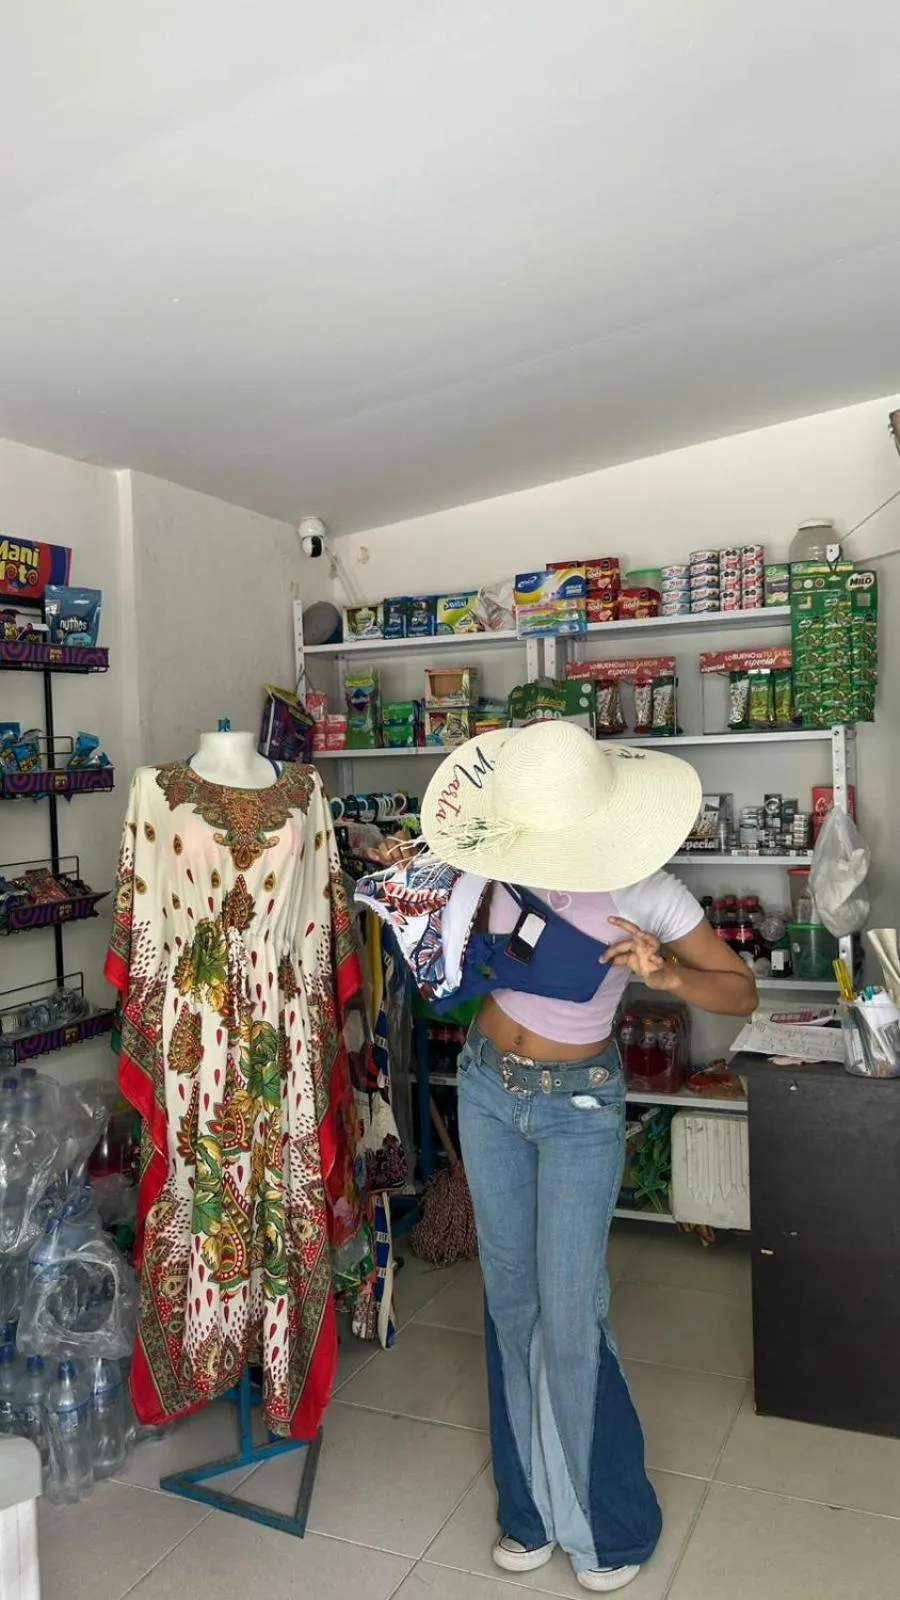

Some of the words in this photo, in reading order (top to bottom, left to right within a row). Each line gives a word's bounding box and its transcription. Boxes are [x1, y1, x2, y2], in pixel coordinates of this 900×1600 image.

[850, 577, 872, 587] MILO
[435, 746, 494, 824] Marta
[682, 838, 719, 850] special
